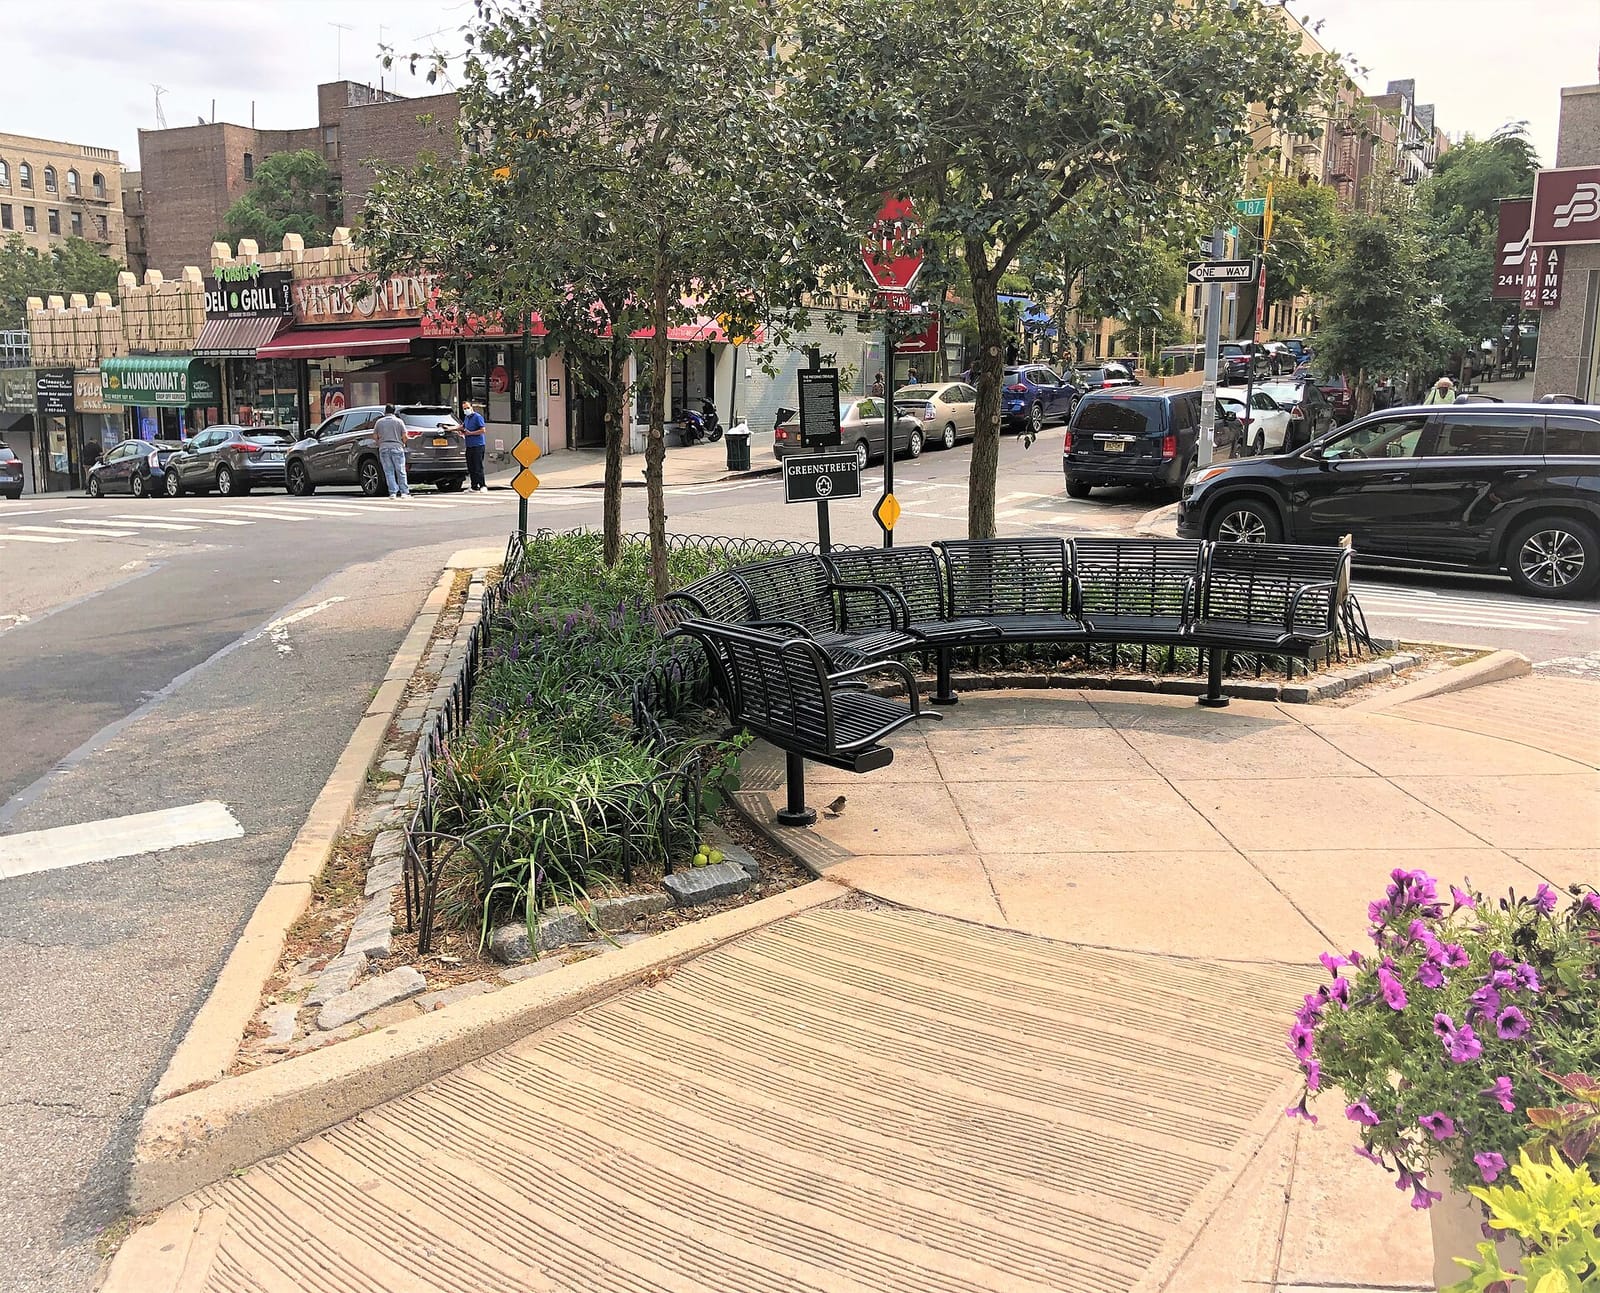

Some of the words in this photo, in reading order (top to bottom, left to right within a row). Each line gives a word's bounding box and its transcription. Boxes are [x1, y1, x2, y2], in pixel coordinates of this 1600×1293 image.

[224, 265, 249, 282] OASIS
[1196, 268, 1215, 277] ONE
[1226, 267, 1248, 276] WAY
[1526, 250, 1538, 287] ATM
[1544, 249, 1559, 287] ATM
[1498, 275, 1513, 285] 24
[204, 290, 228, 312] DELI
[241, 287, 277, 311] GRILL
[282, 284, 290, 311] DELI
[297, 283, 354, 315] VINES
[1524, 289, 1537, 300] 24
[1541, 289, 1558, 300] 24
[121, 371, 179, 390] LAUNDROMAT
[788, 461, 857, 476] GREENSTREETS
